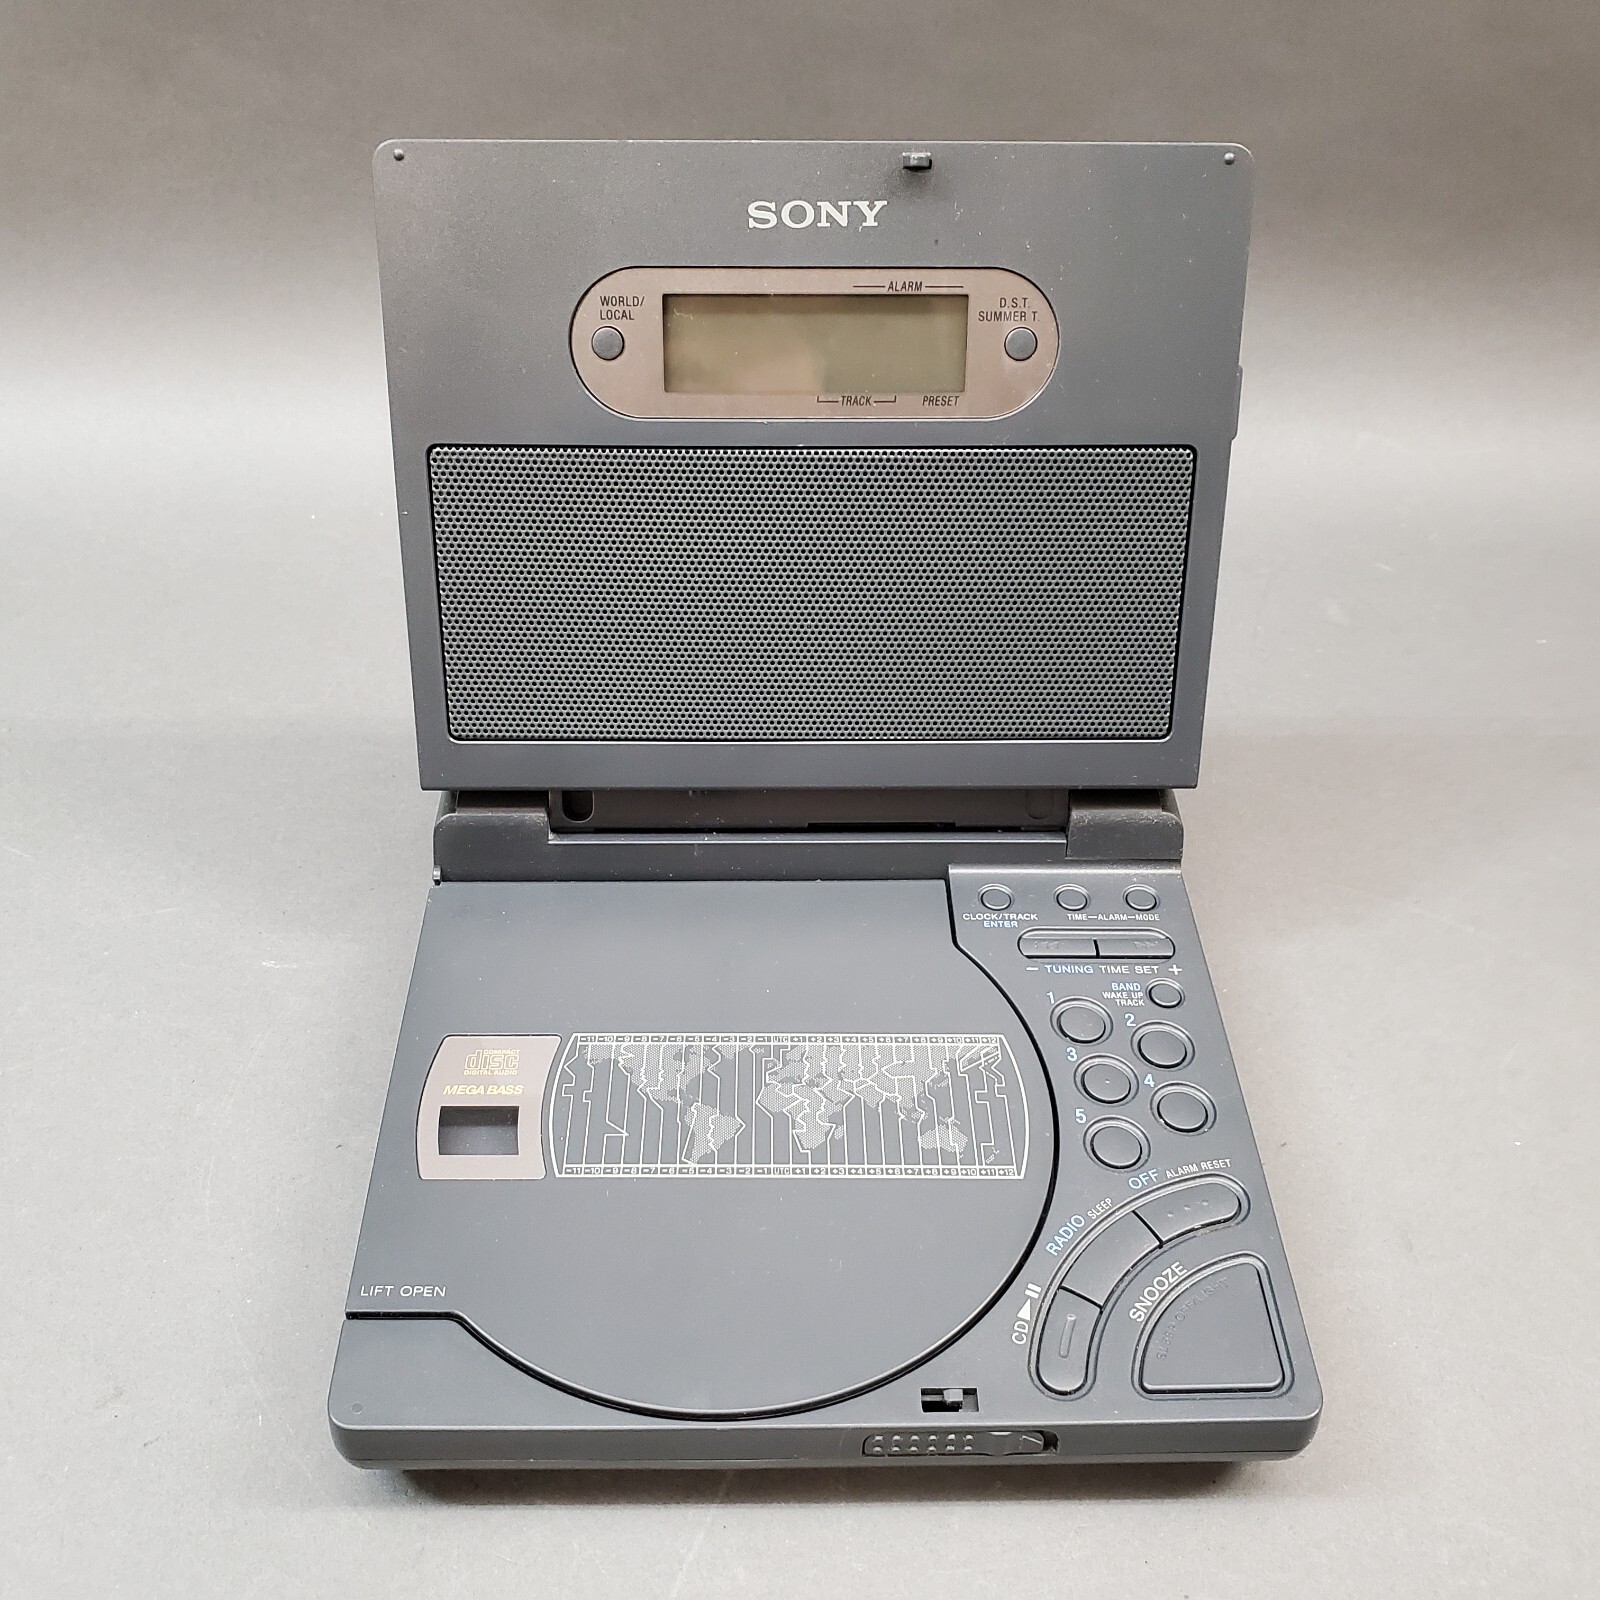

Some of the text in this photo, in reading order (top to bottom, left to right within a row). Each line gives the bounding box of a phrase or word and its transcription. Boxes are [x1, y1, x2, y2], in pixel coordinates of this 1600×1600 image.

[747, 200, 889, 230] SONY
[887, 280, 924, 293] ALARM
[600, 296, 645, 308] WORLD/
[999, 297, 1032, 309] D.S.T.
[600, 309, 635, 321] LOCAL
[978, 310, 1041, 323] SUMMER T.
[840, 395, 873, 407] TRACK
[922, 395, 960, 407] PRESET
[962, 913, 1039, 921] CLOCK/TRACK
[1067, 913, 1088, 921] TIME
[1097, 913, 1128, 921] ALARM
[983, 920, 1018, 929] ENTER
[1044, 965, 1159, 974] TUNING TIME SET
[1111, 982, 1141, 991] BAND
[1047, 991, 1055, 1004] 1
[1102, 991, 1128, 999] WAKE
[1115, 999, 1145, 1007] TRACK
[1124, 1013, 1136, 1027] 2
[464, 1049, 520, 1070] disc
[1066, 1048, 1078, 1061] 3
[1143, 1073, 1155, 1087] 4
[442, 1085, 525, 1095] MEGA BASS
[1075, 1109, 1087, 1123] 5
[1128, 1158, 1232, 1191] OFF ALARM RESET
[1045, 1197, 1113, 1257] RADIO SLEEP
[360, 1285, 447, 1297] LIFT OPEN
[1129, 1261, 1188, 1323] SNOOZE
[1011, 1320, 1031, 1345] CD
